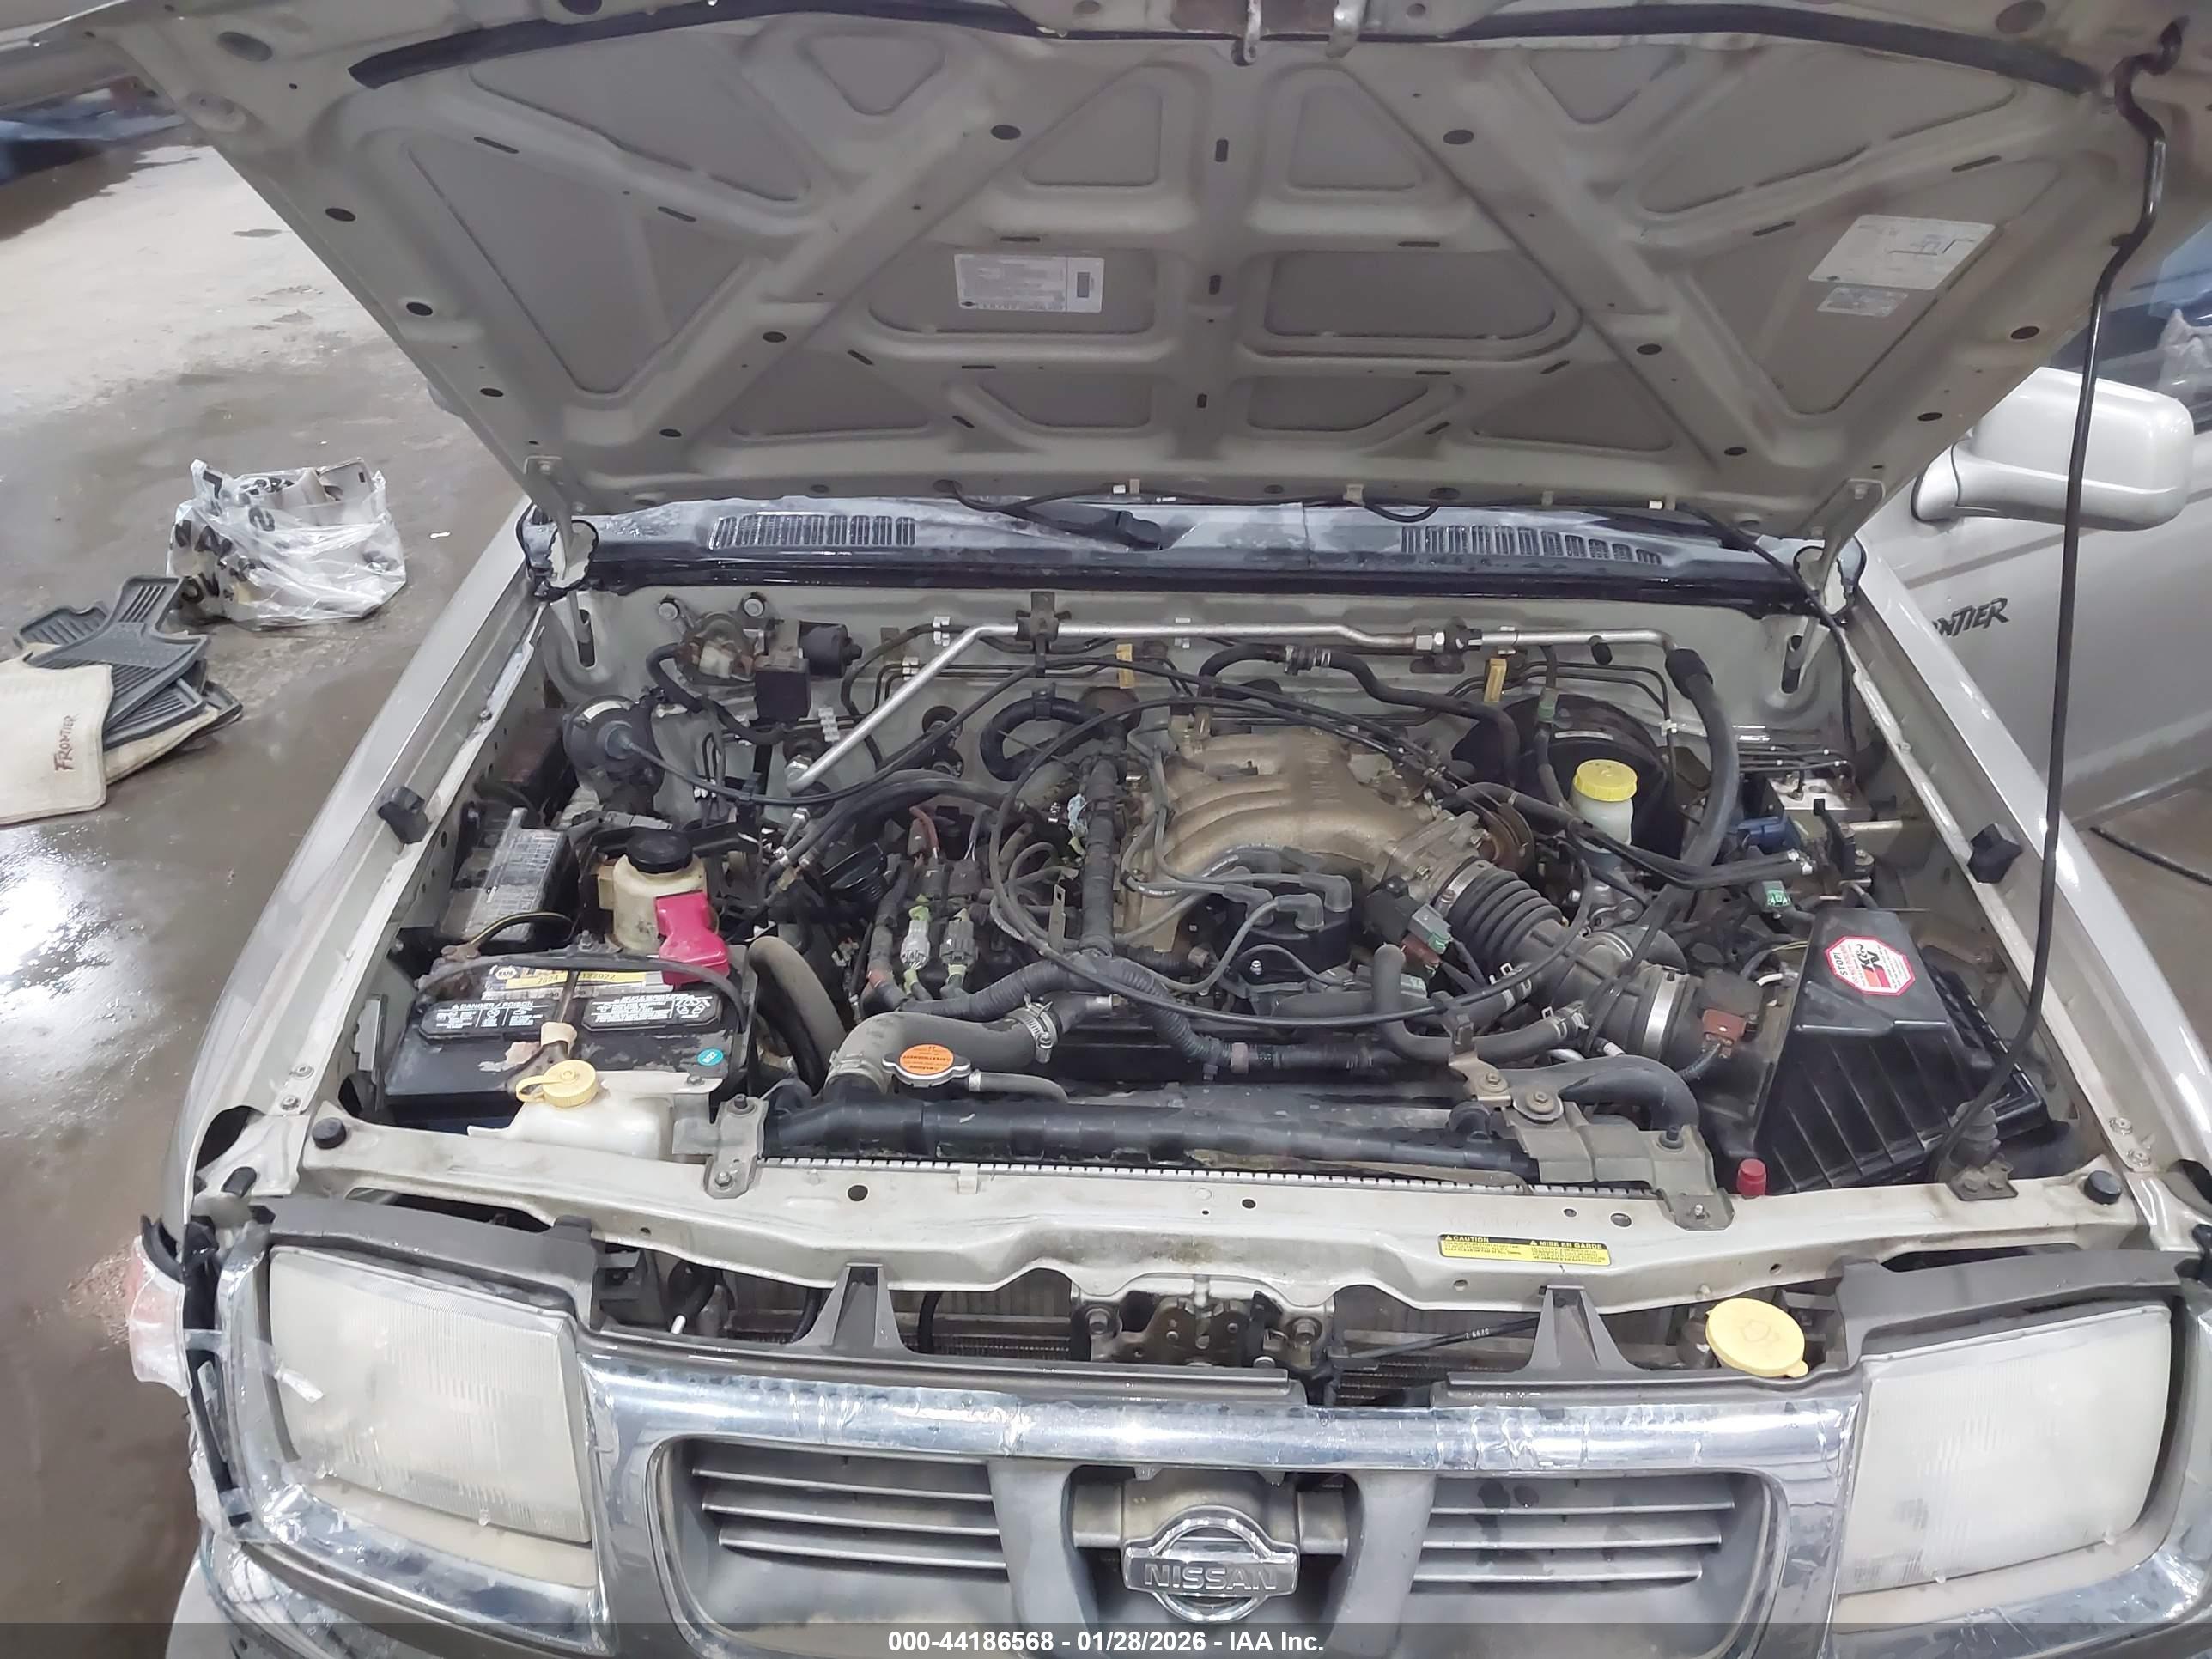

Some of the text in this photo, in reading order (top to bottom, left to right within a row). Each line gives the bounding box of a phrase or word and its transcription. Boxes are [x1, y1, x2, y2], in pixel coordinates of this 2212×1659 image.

[53, 713, 82, 771] FRONTIER
[1832, 952, 1848, 976] STOP!
[1144, 1562, 1277, 1590] NISSAN
